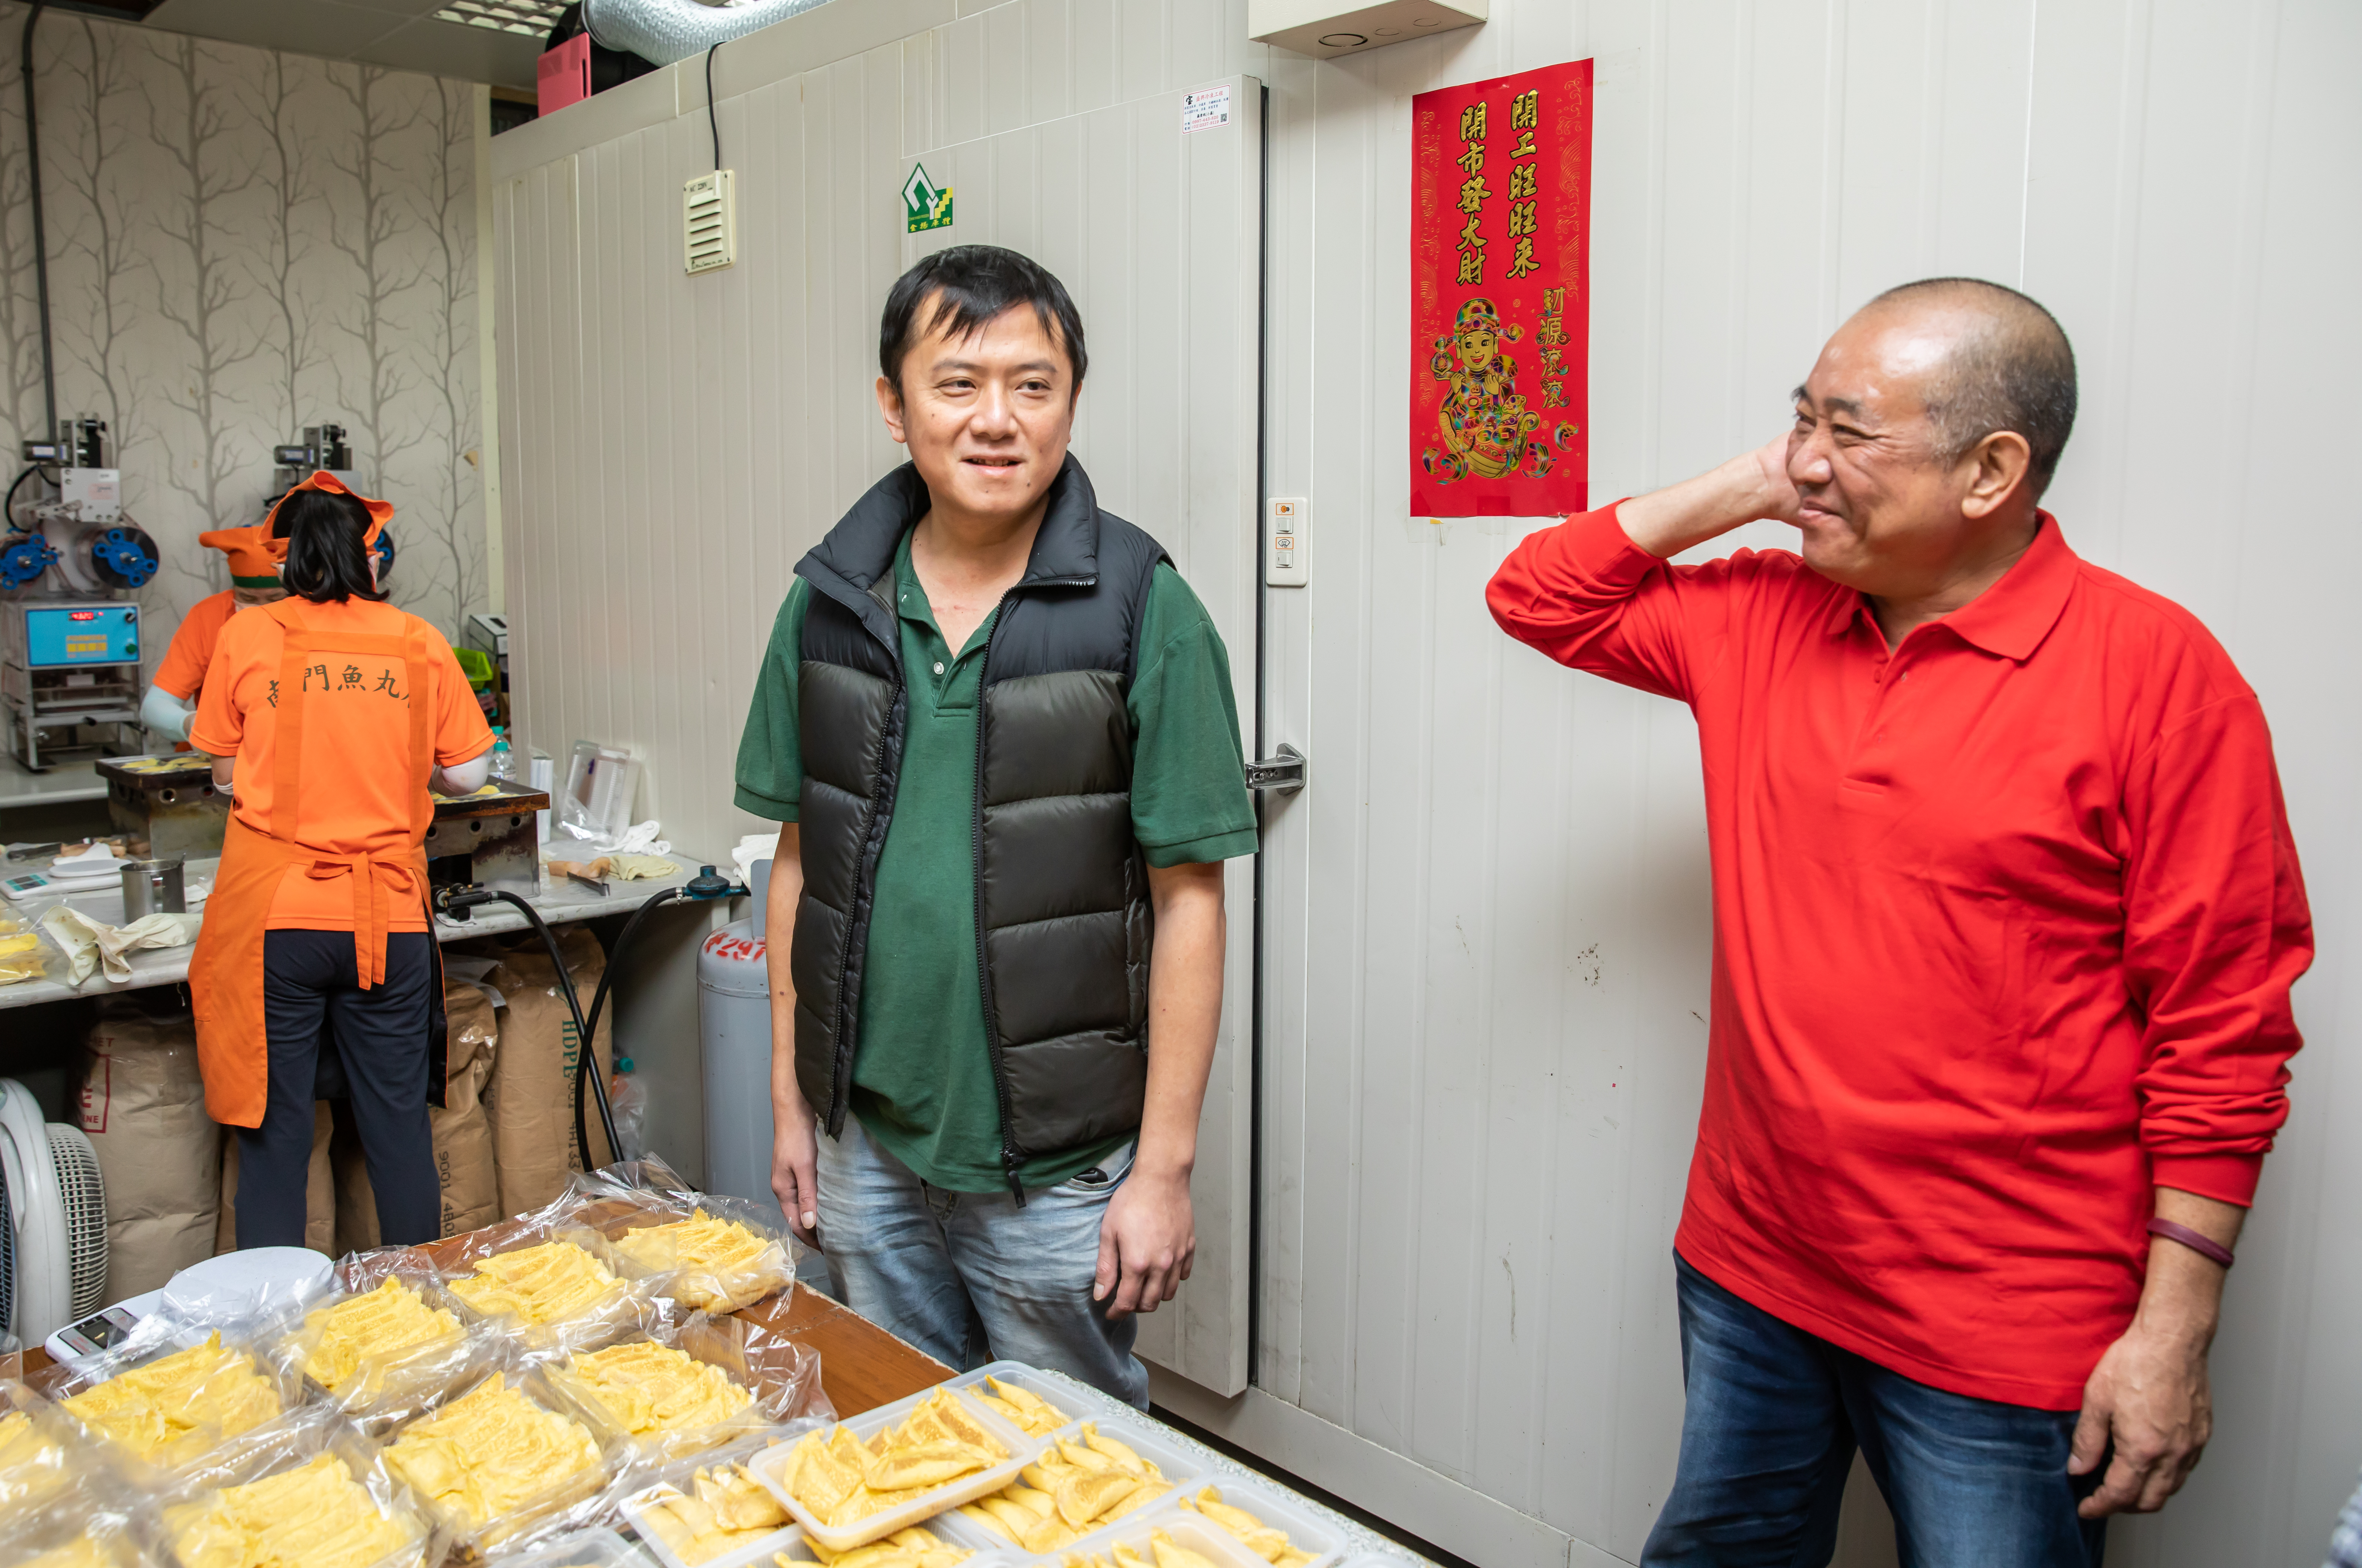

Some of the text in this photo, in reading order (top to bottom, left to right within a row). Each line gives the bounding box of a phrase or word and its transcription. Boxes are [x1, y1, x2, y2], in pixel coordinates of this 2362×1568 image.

[1192, 115, 1219, 124] 0987-443-820
[1456, 101, 1492, 286] 開市發大財
[1536, 286, 1571, 409] 財源滾滾
[562, 1019, 578, 1078] HDPE
